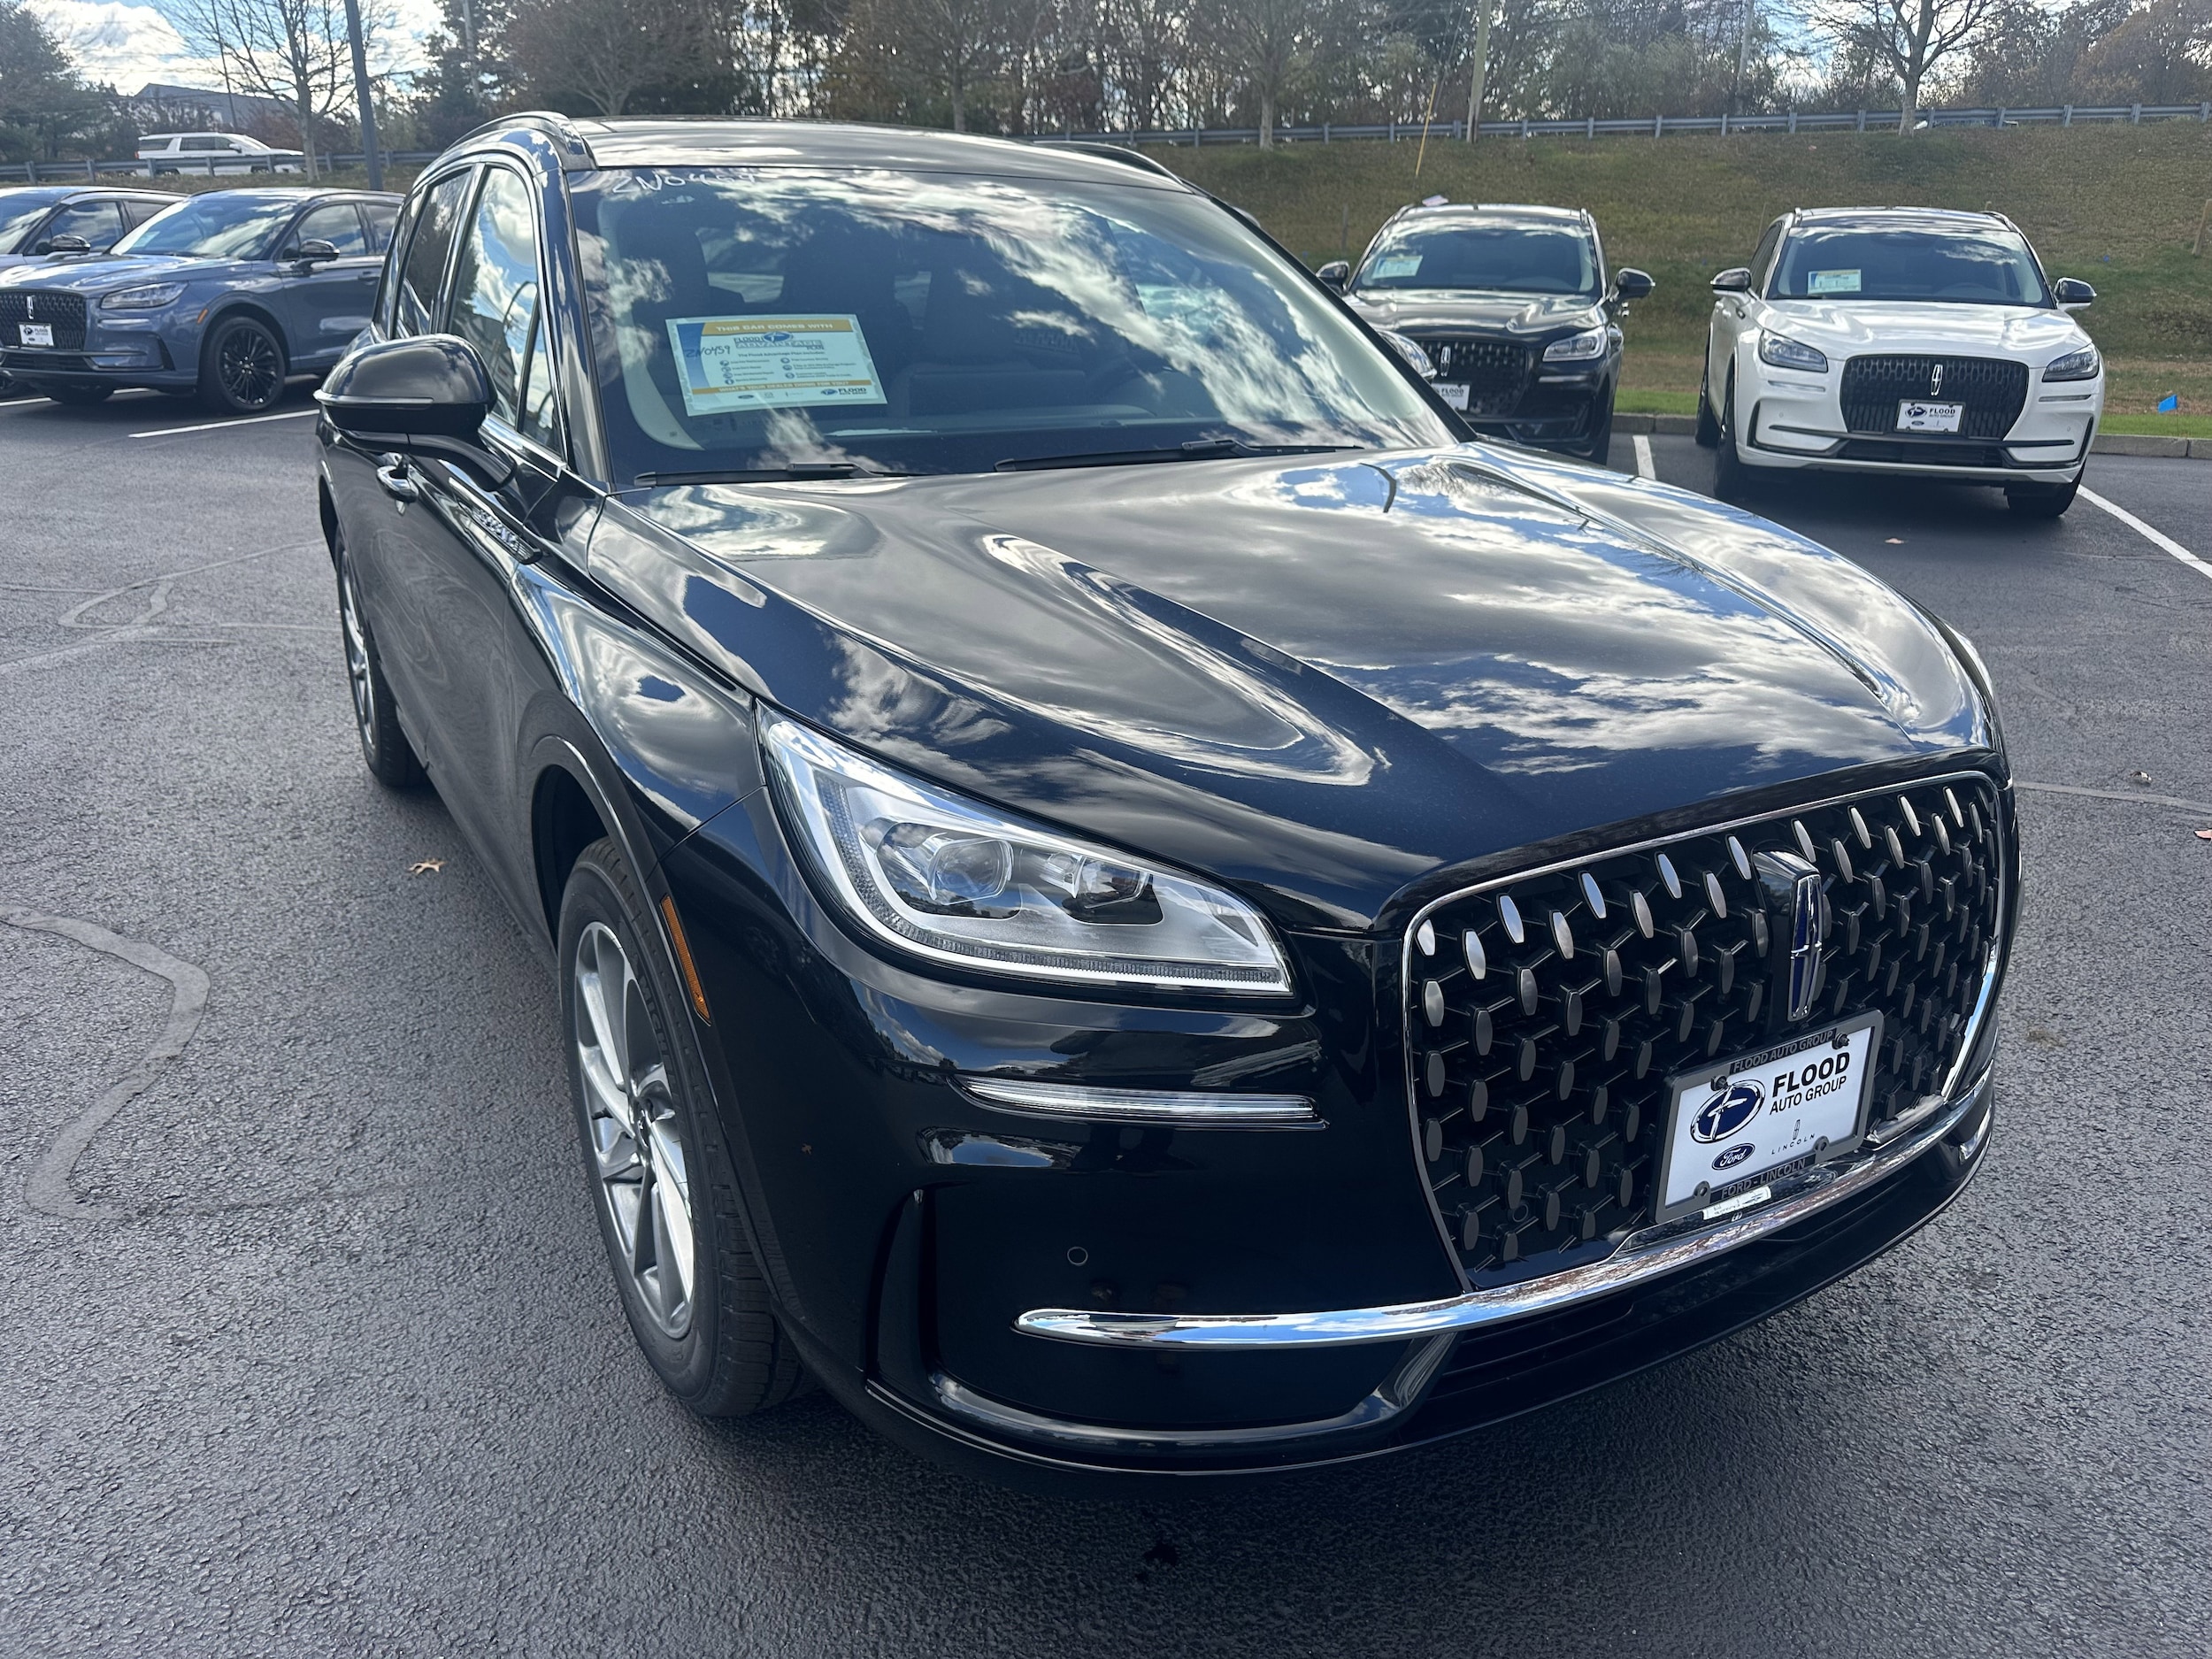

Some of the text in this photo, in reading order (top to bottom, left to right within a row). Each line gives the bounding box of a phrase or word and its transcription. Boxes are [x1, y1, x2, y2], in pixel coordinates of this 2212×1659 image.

[1733, 1030, 1833, 1071] FLOOD AUTO GROUP
[1770, 1075, 1847, 1116] AUTO GROUP
[1772, 1052, 1850, 1098] FLOOD
[1719, 1148, 1747, 1167] Ford
[1771, 1133, 1816, 1155] LINCOLN
[1721, 1180, 1753, 1199] FORD
[1760, 1158, 1806, 1184] LINCOLN
